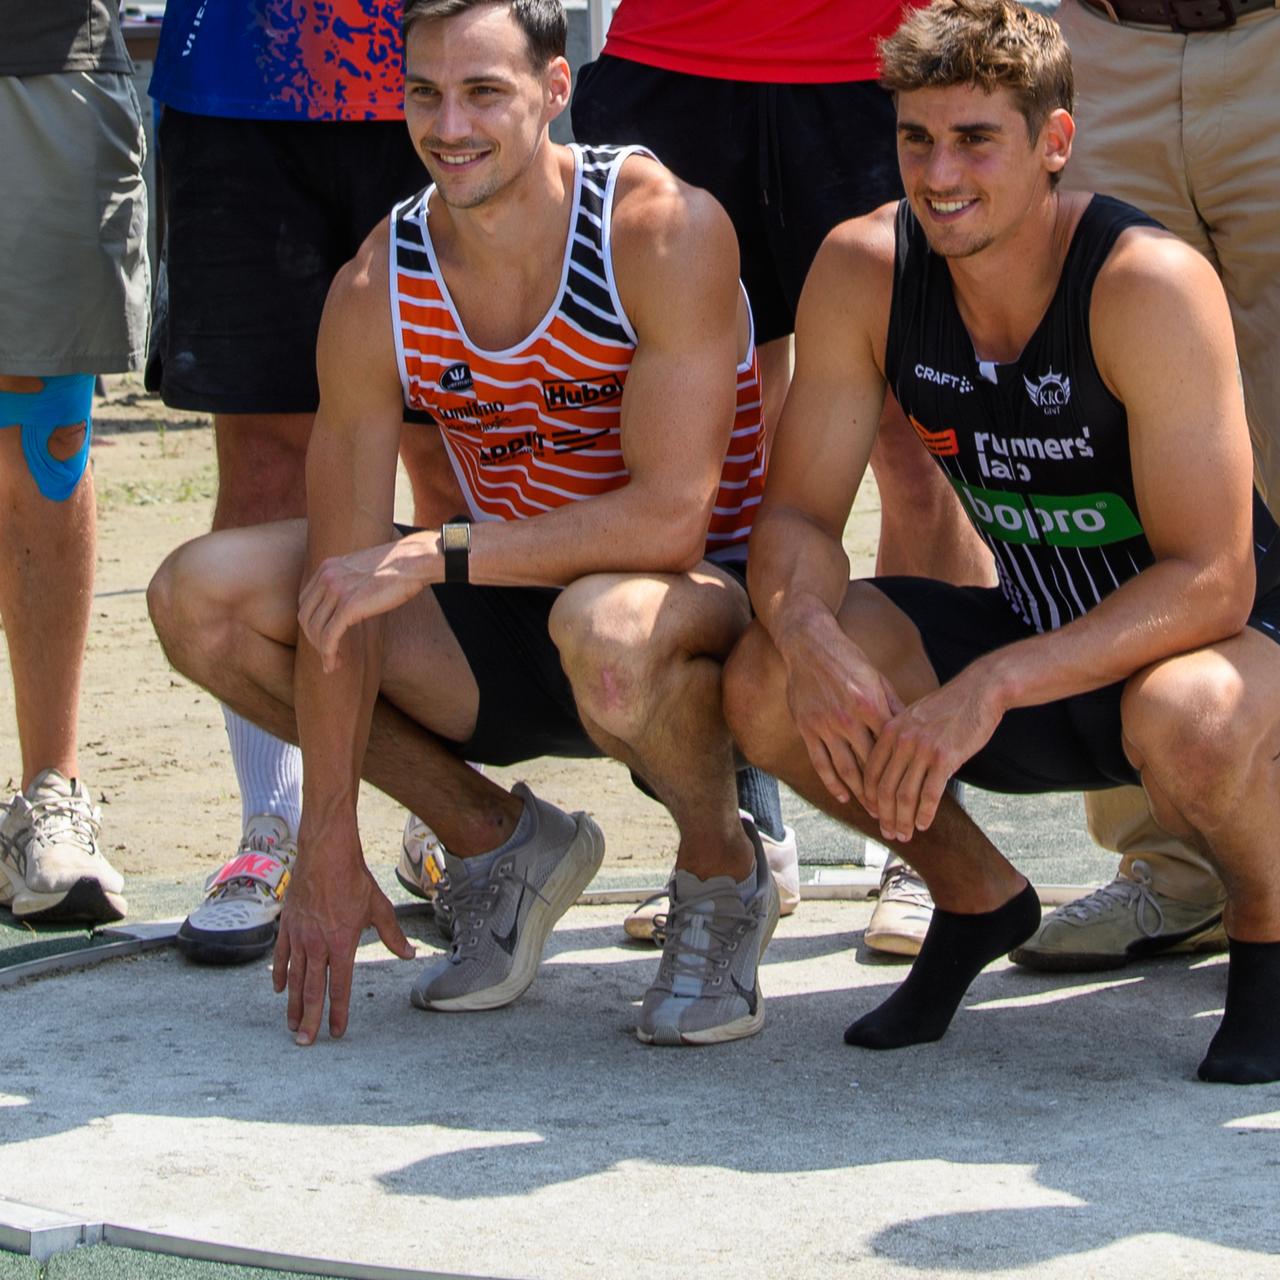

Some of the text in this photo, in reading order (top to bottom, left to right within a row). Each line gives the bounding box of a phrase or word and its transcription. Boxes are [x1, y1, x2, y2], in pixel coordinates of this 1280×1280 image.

[914, 363, 960, 389] CRAFT
[548, 383, 617, 406] Hubo
[1039, 388, 1065, 406] KRC
